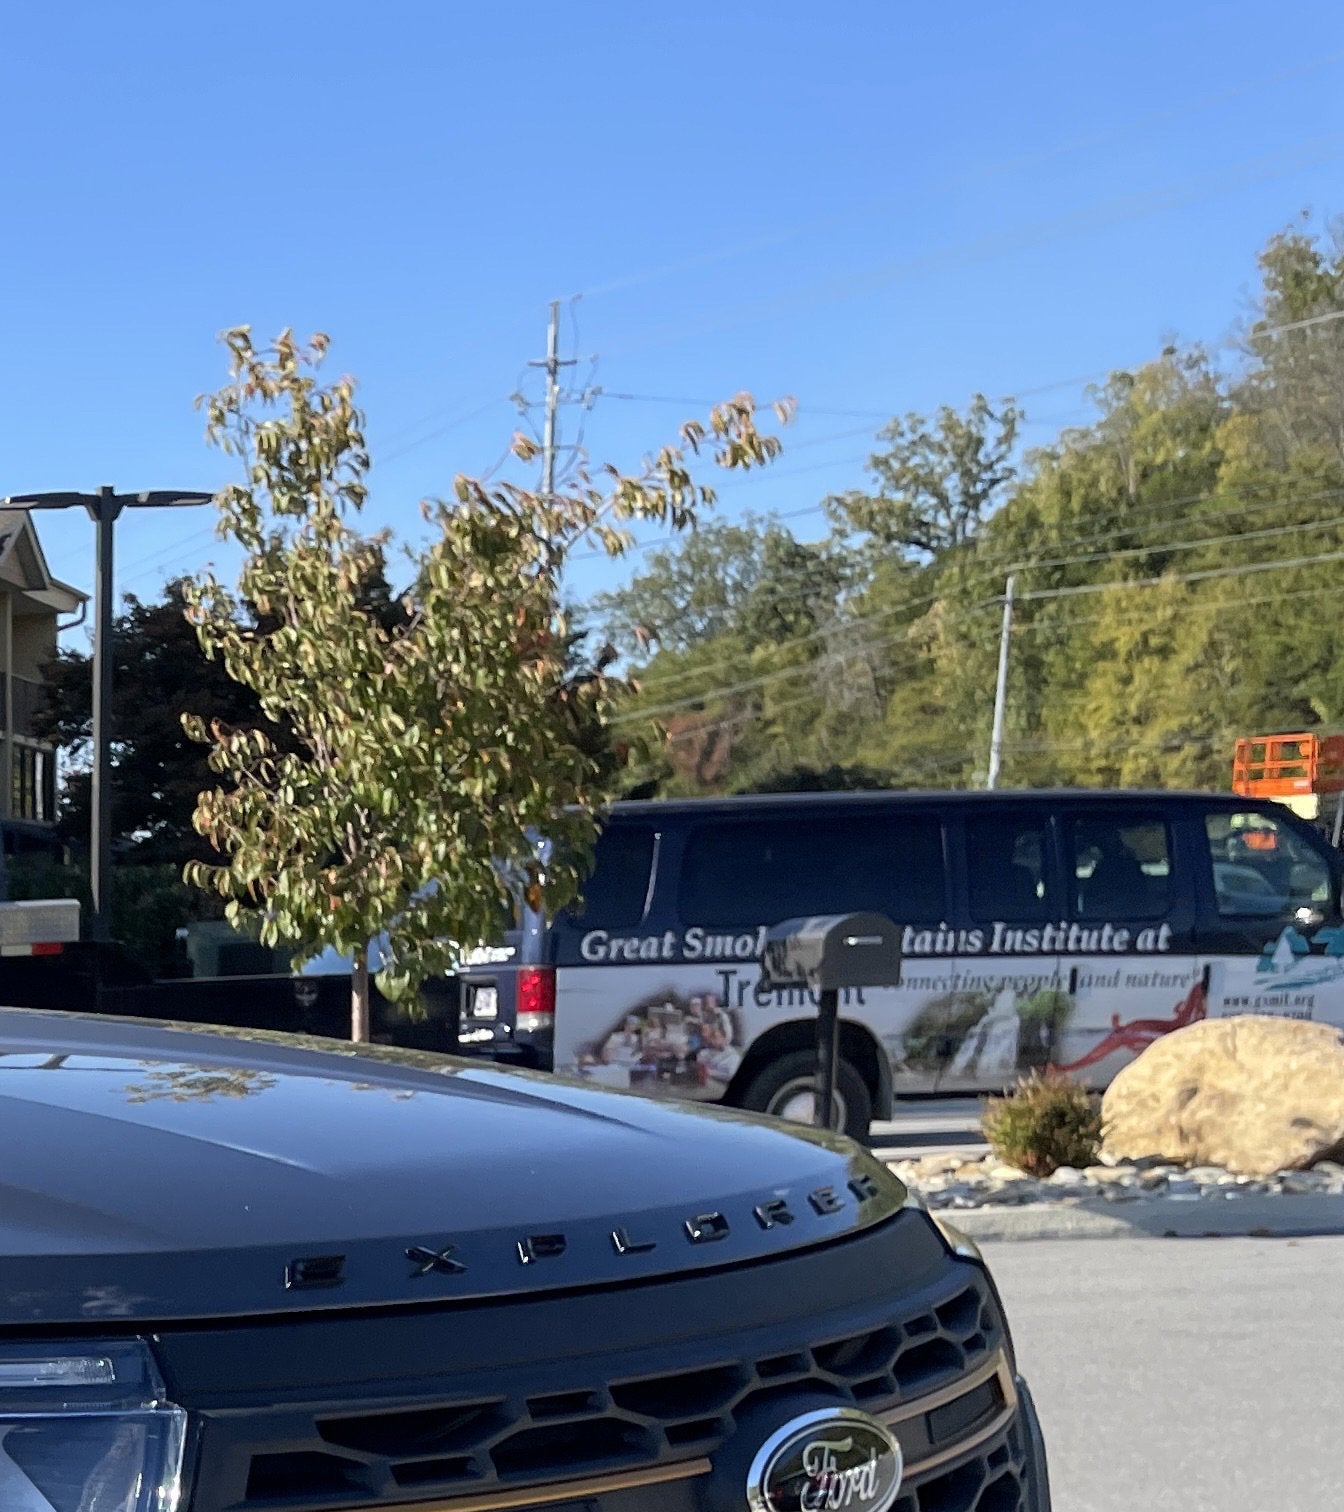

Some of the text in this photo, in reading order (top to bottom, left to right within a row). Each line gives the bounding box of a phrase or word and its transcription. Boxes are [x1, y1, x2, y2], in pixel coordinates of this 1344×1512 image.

[581, 920, 1173, 961] Great Smo tains Institute at
[283, 1174, 880, 1291] EXPLORER
